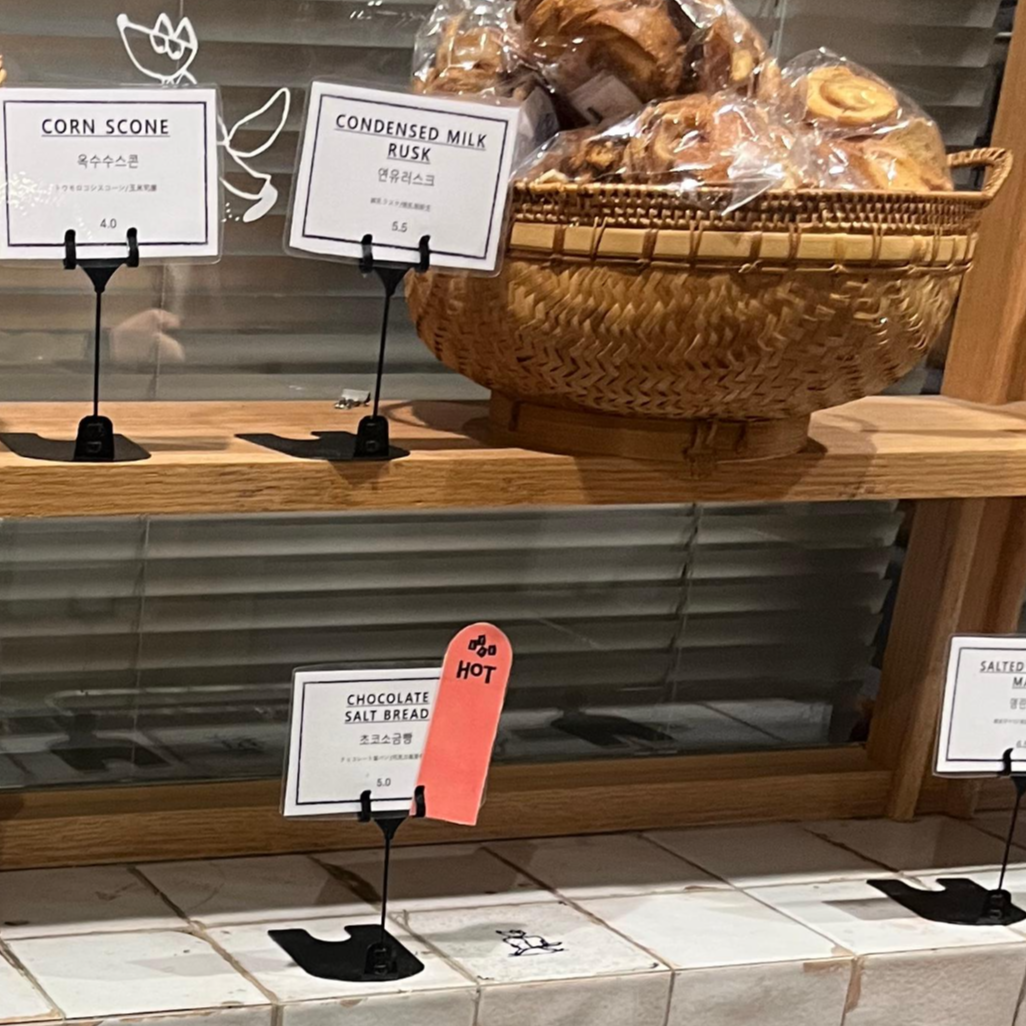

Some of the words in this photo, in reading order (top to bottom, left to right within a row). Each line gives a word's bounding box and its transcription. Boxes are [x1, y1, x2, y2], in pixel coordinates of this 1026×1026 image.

[41, 118, 96, 135] CORN
[105, 118, 170, 135] SCONE
[335, 114, 440, 141] CONDENSED
[446, 129, 488, 149] MILK
[387, 142, 432, 162] RUSK
[77, 153, 139, 169] 옥수수스콘
[377, 167, 435, 187] 연유러스크
[99, 218, 117, 229] 4.0
[391, 220, 408, 233] 5.5
[455, 660, 497, 684] HOT
[980, 660, 1025, 672] SALTED
[347, 691, 429, 706] CHOCOLATE
[344, 709, 377, 722] SALT
[383, 708, 430, 721] BREAD
[359, 732, 413, 745] 초코소금빵
[376, 777, 391, 787] 5.0
